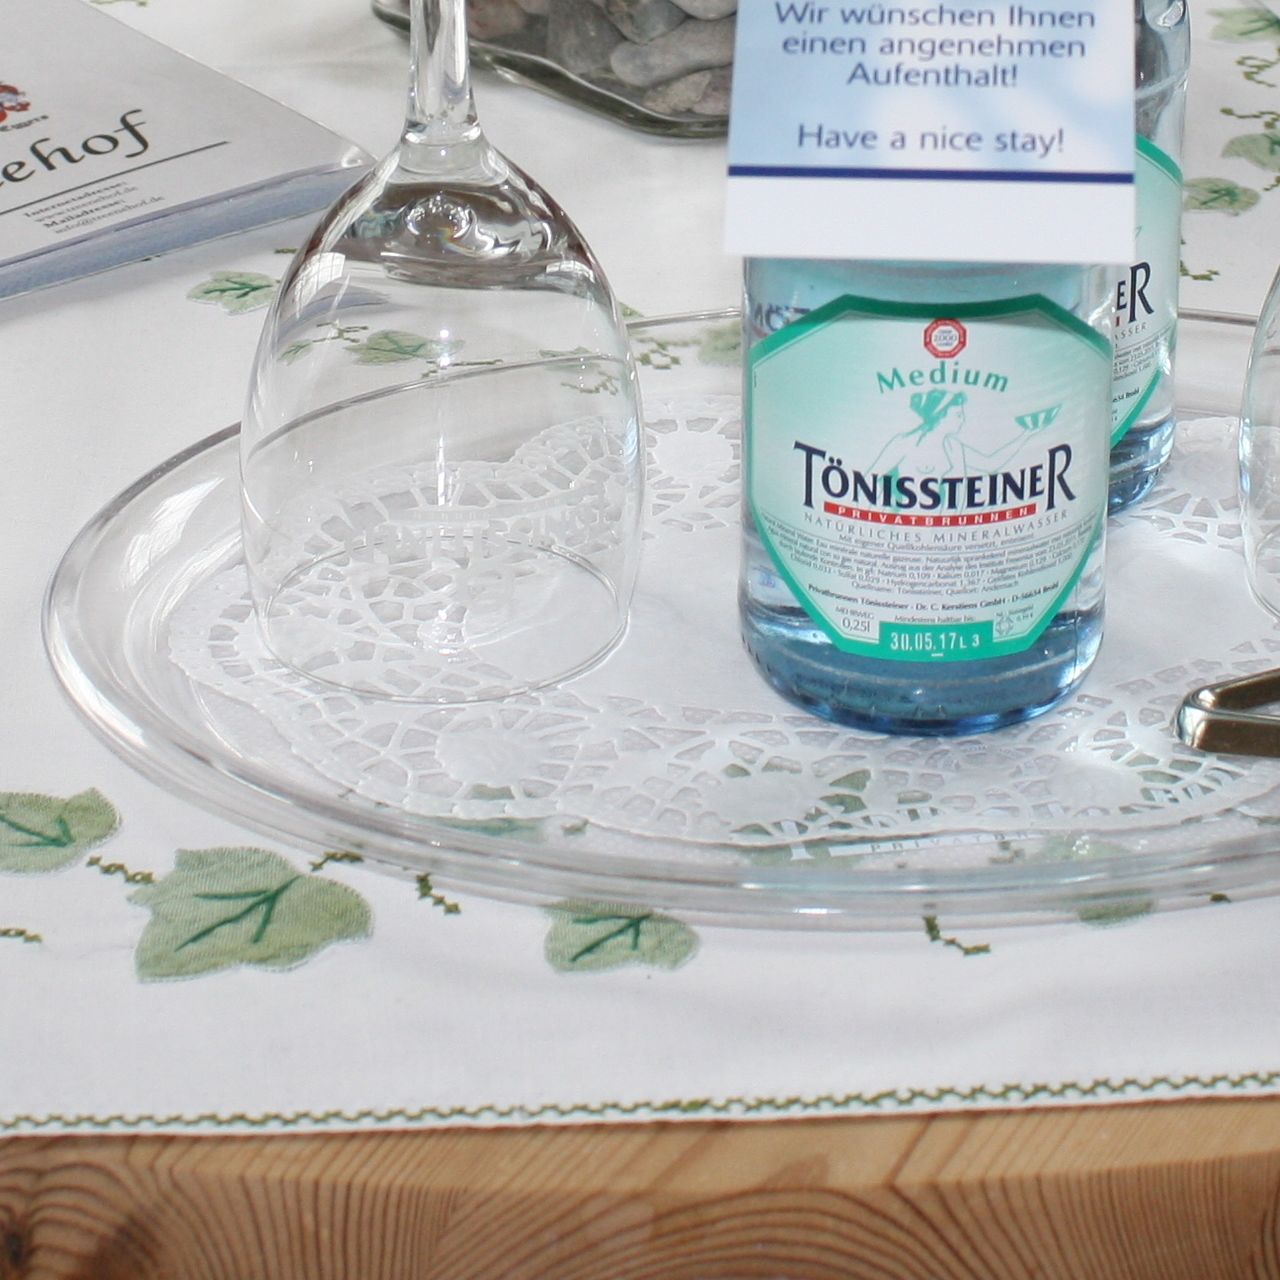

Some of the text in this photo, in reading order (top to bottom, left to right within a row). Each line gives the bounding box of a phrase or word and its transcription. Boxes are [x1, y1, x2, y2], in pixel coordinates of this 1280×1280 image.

[775, 1, 1096, 28] Wir wünschen Ihnen
[782, 32, 1086, 61] einen angenehmen
[846, 61, 1019, 88] Aufenthalt!
[797, 125, 1065, 158] Have a nice stay!
[876, 360, 1009, 394] Medium
[793, 441, 1076, 510] TÖNISSTEINER
[837, 505, 1029, 526] PRIVATBRUNNEN
[933, 508, 1069, 544] MINERALWASSER
